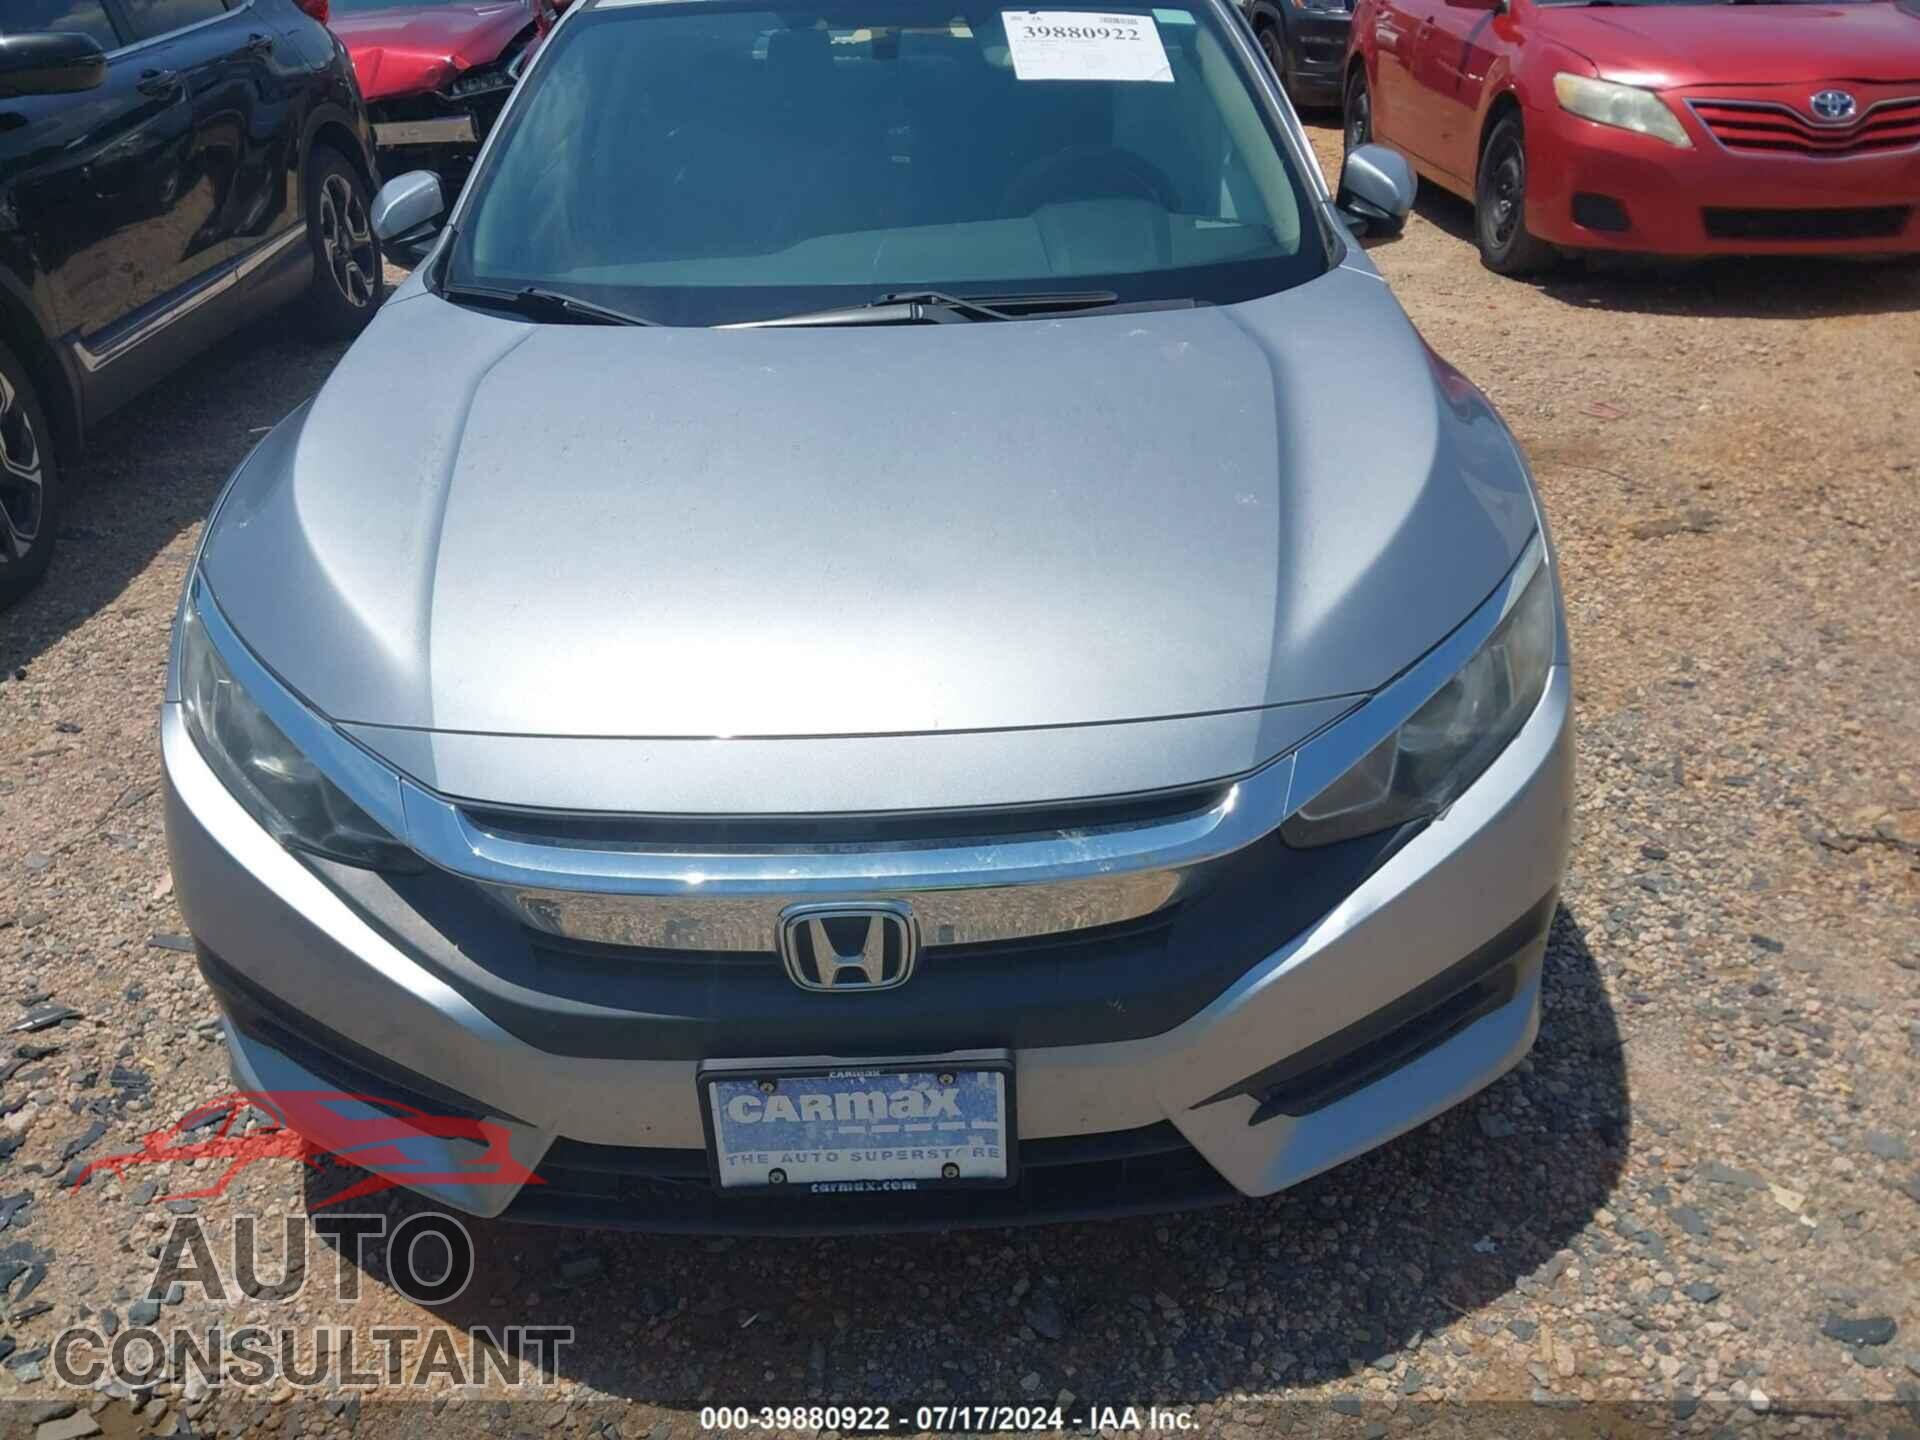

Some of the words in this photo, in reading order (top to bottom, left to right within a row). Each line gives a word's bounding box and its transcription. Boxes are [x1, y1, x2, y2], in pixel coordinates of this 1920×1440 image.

[1023, 25, 1141, 41] 39880922
[726, 1153, 769, 1166] THE
[781, 1151, 839, 1163] AUTO
[850, 1146, 1000, 1162] SUPERSTRE
[810, 1180, 918, 1193] carmax.com
